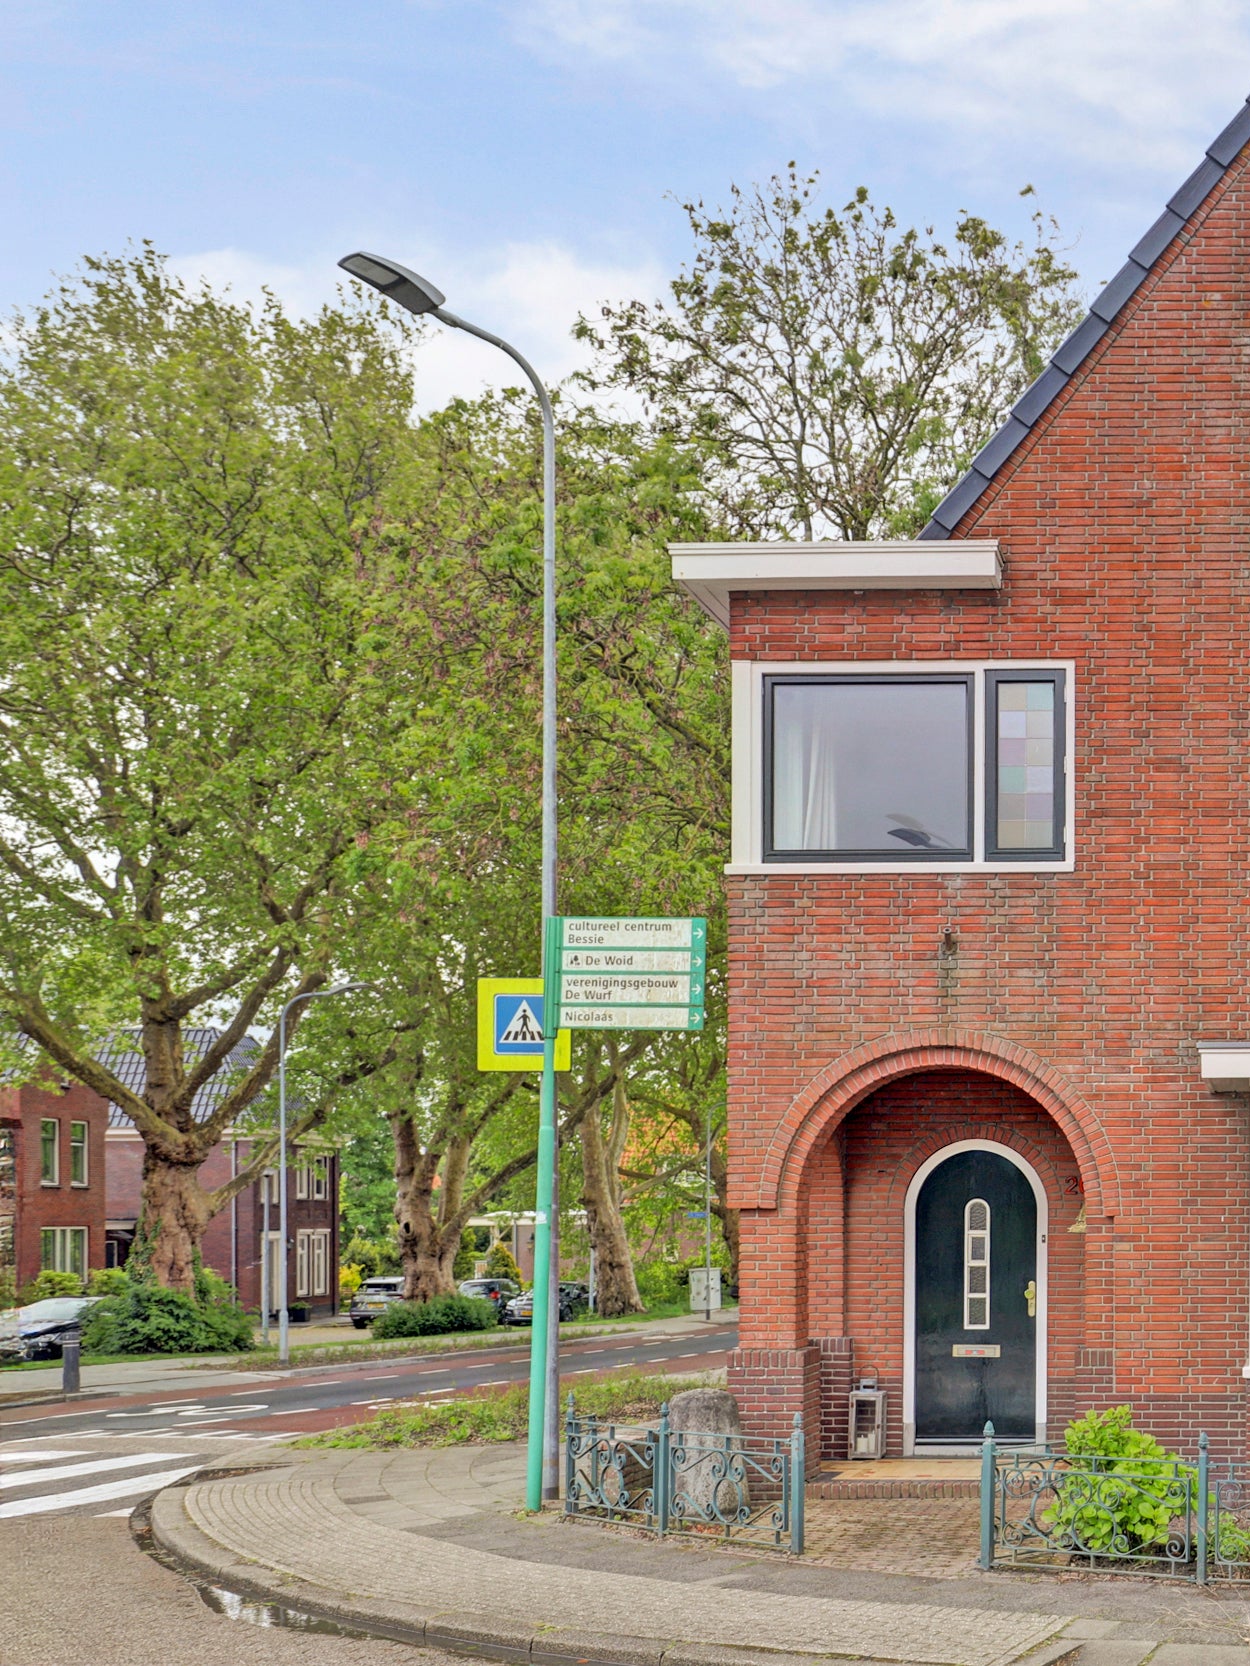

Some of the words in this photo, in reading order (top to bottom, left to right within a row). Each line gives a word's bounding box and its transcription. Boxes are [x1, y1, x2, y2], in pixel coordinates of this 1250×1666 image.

[568, 921, 620, 932] cultureel
[624, 923, 672, 932] centrum
[568, 934, 604, 944] Bessie
[585, 956, 600, 966] De
[604, 956, 633, 966] Woid
[566, 978, 678, 990] verenigingsgebouw
[565, 990, 580, 1000] De
[584, 990, 612, 1001] Wurf
[564, 1012, 613, 1022] Nicolaas
